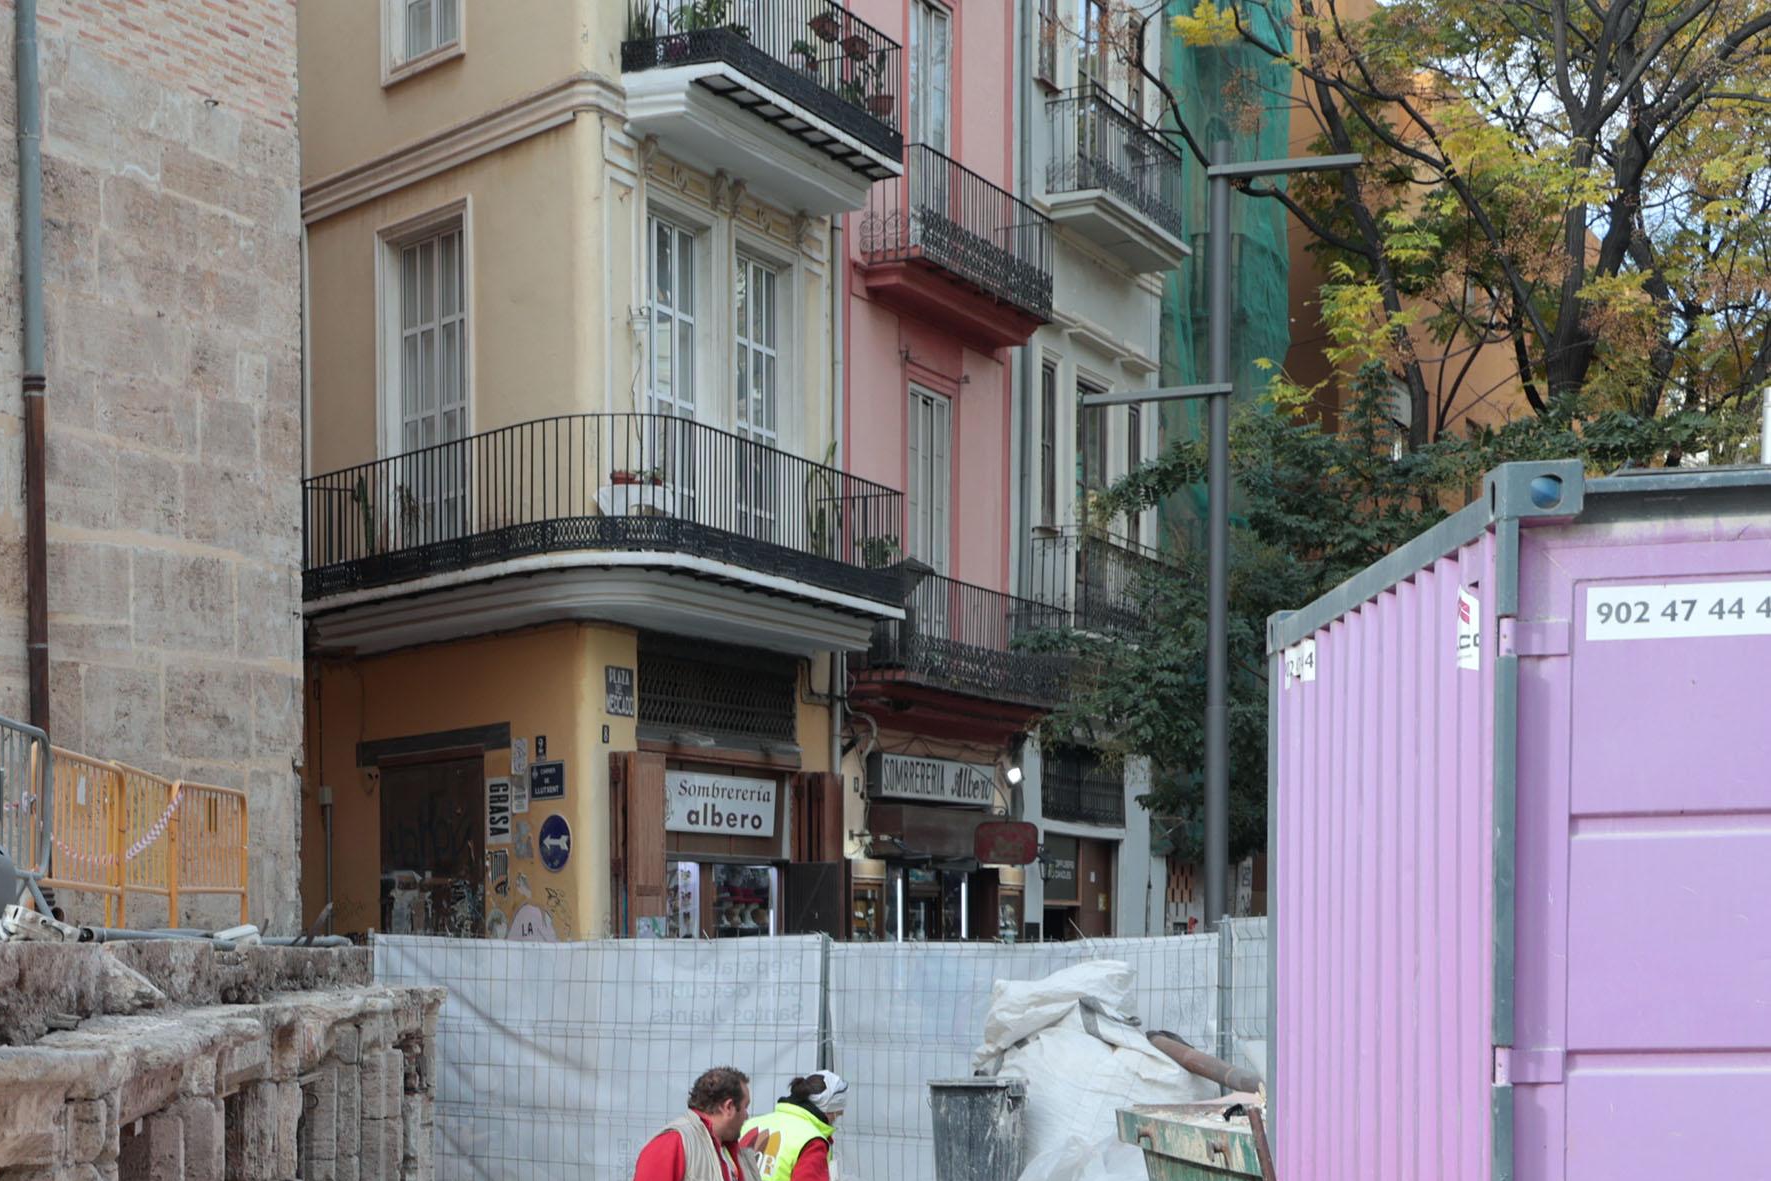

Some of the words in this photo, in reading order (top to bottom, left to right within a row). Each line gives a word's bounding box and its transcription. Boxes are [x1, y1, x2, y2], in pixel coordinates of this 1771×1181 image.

[1596, 600, 1650, 625] 902
[1660, 599, 1697, 622] 47
[1708, 597, 1745, 620] 44
[1756, 595, 1771, 619] 4
[608, 667, 630, 685] PLAZA
[606, 693, 633, 716] MERCADO
[678, 779, 771, 803] Sombrerería
[883, 758, 945, 797] SOMBRERERIA
[951, 767, 992, 801] Albero
[489, 783, 509, 836] GRASA
[686, 802, 763, 830] albero
